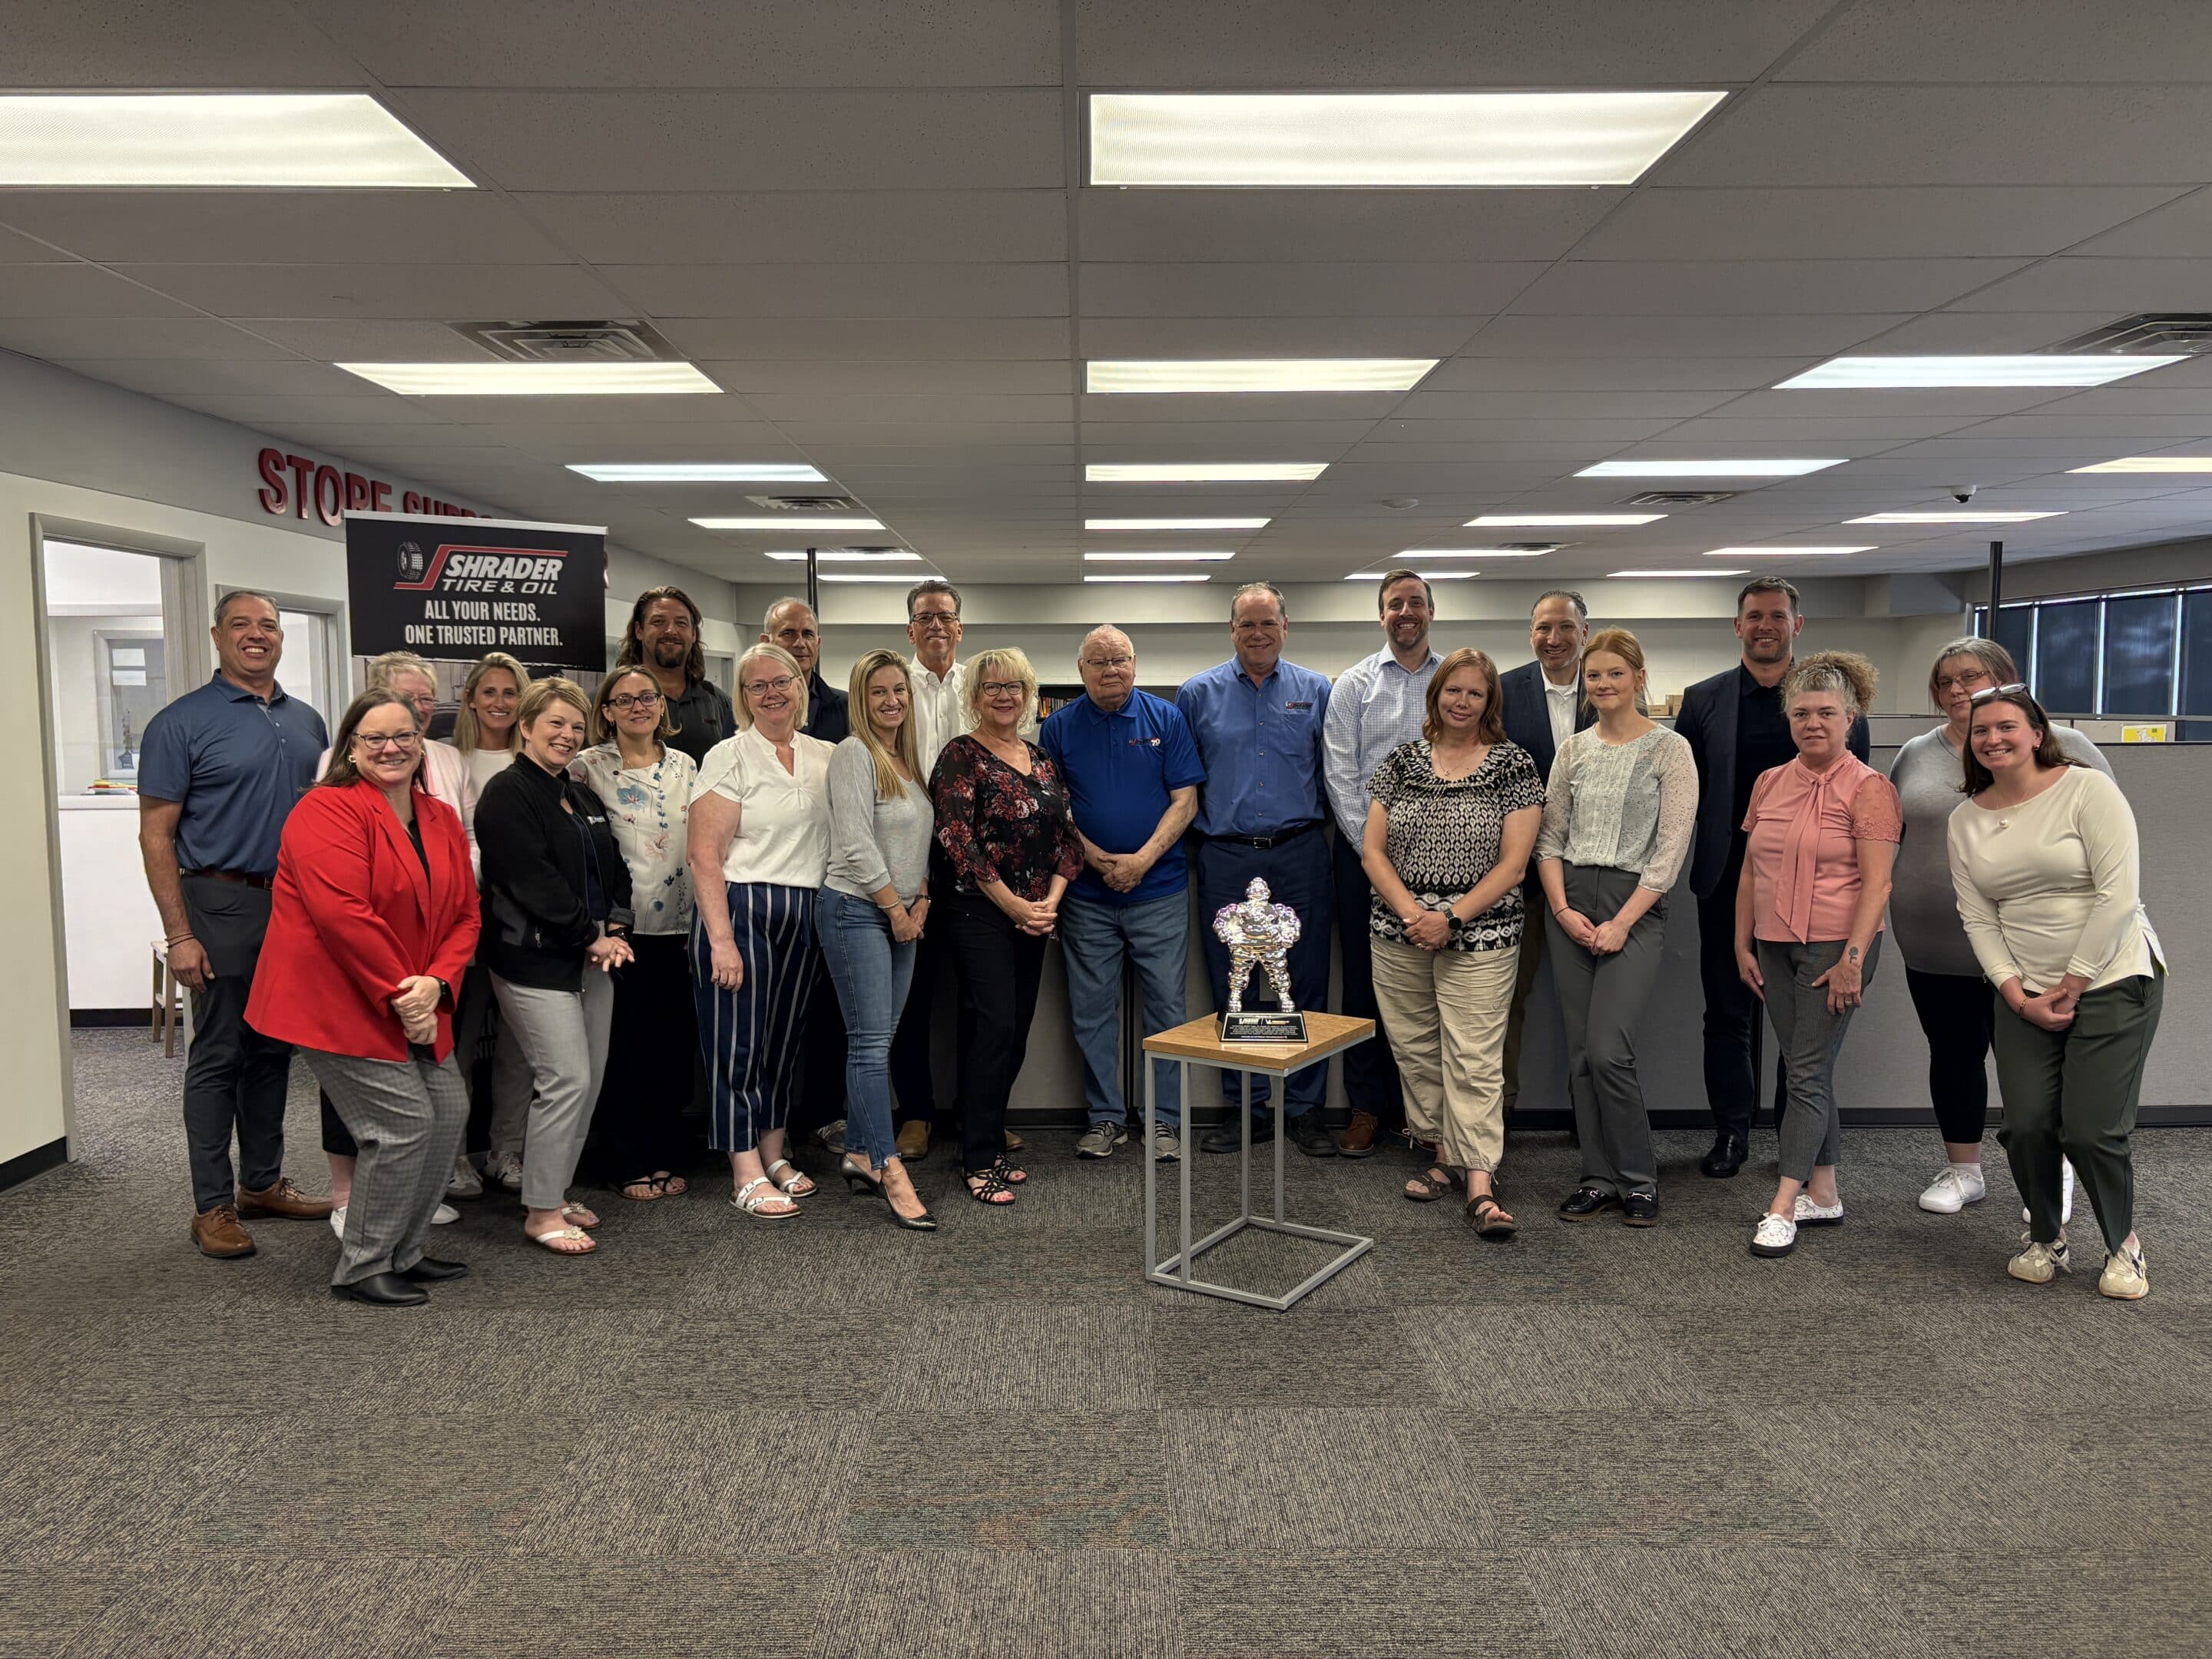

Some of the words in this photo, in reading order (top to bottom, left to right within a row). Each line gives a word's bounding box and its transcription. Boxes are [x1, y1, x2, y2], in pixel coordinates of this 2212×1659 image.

[445, 555, 563, 581] SHRADER
[442, 578, 498, 593] TIRE
[500, 581, 515, 594] &
[520, 581, 558, 595] OIL
[425, 600, 450, 620] ALL
[452, 600, 489, 621] YOUR
[493, 601, 541, 622] NEEDS.
[405, 624, 434, 644] ONE
[436, 624, 496, 645] TRUSTED
[500, 626, 564, 647] PARTNER.
